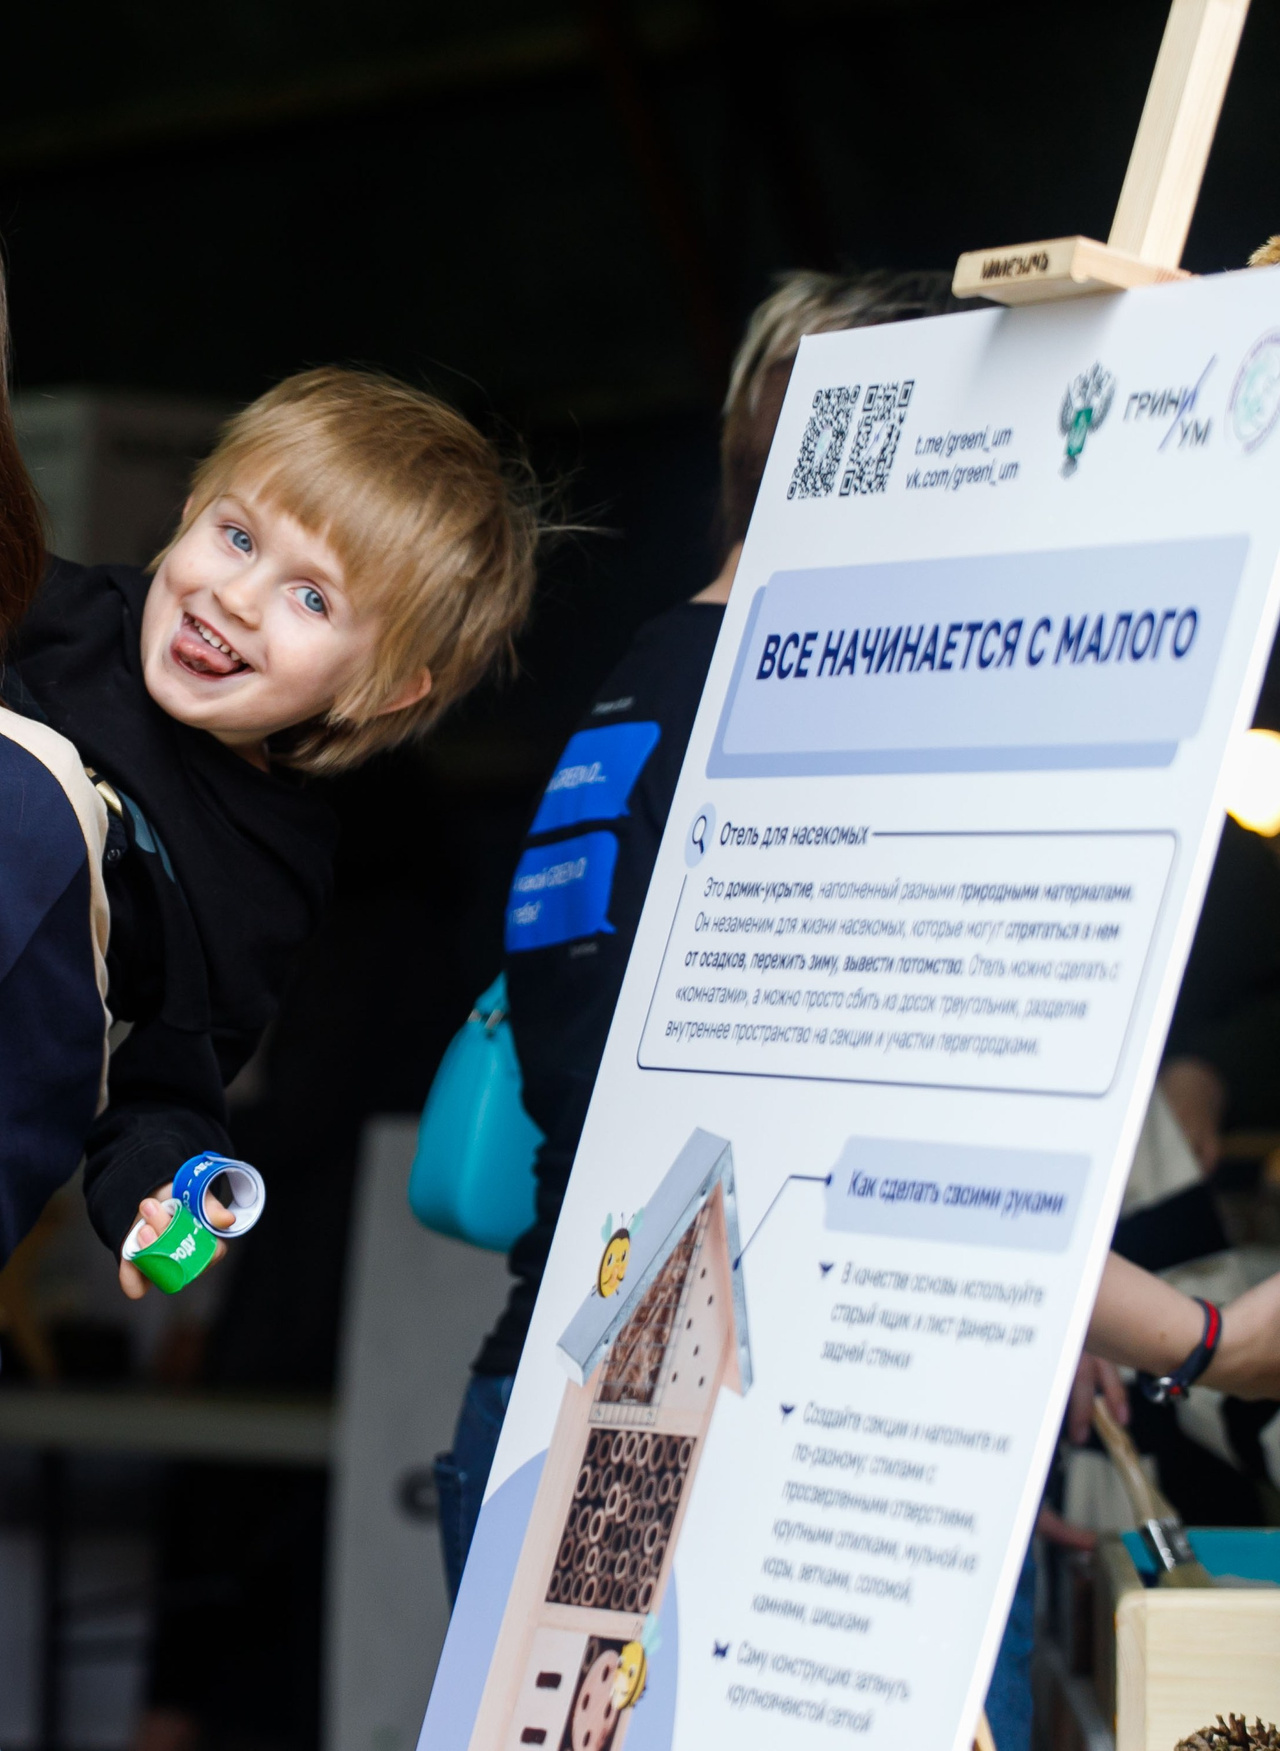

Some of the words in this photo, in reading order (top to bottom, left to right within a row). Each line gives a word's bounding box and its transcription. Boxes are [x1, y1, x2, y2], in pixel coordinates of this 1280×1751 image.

[915, 424, 1012, 458] t.me/greeni_um
[906, 458, 1019, 491] vk.com/greeni_um
[756, 632, 818, 680] ВСЕ
[817, 617, 1024, 679] НАЧИНАЕТСЯ
[1026, 616, 1052, 667] С
[1053, 606, 1200, 665] МАЛОГО
[720, 822, 758, 846] Отель
[760, 826, 786, 849] для
[789, 825, 870, 846] насекомых
[704, 877, 724, 897] Это
[724, 880, 814, 903] домик-укрытие,
[818, 877, 901, 900] наполненный
[899, 883, 956, 904] разными
[958, 882, 1039, 904] природными
[1043, 883, 1133, 906] материалами.
[694, 912, 709, 932] Он
[711, 917, 773, 933] незаменим
[774, 917, 797, 935] для
[800, 918, 836, 935] жизни
[838, 918, 906, 938] насекомых,
[910, 919, 963, 942] которые
[967, 920, 1002, 944] могут
[1005, 921, 1080, 944] спрятаться
[1081, 922, 1092, 939] в
[1093, 922, 1121, 940] нем
[685, 950, 699, 967] от
[699, 951, 747, 970] осадков,
[749, 952, 806, 975] пережить
[807, 954, 838, 976] зиму,
[842, 955, 894, 973] вывести
[894, 956, 964, 975] потомство.
[968, 953, 1005, 977] Отель
[1007, 960, 1052, 979] можно
[1054, 961, 1107, 982] сделать
[1108, 962, 1121, 982] с
[675, 985, 750, 1007] «комнатами»,
[751, 990, 760, 1005] а
[762, 988, 799, 1007] можно
[805, 988, 844, 1013] просто
[845, 987, 880, 1011] сбить
[881, 994, 897, 1011] из
[898, 993, 937, 1014] досок
[940, 995, 1020, 1020] треугольник,
[1022, 998, 1089, 1023] разделив
[665, 1019, 731, 1044] внутреннее
[731, 1022, 810, 1046] пространство
[813, 1026, 827, 1044] на
[829, 1027, 873, 1048] секции
[874, 1030, 884, 1048] и
[886, 1031, 935, 1054] участки
[937, 1033, 1040, 1058] перегородками.
[847, 1169, 877, 1197] Как
[879, 1178, 939, 1204] сделать
[942, 1182, 1002, 1207] своими
[1001, 1190, 1068, 1218] руками
[841, 1261, 852, 1284] В
[852, 1269, 909, 1291] качестве
[910, 1276, 958, 1297] основы
[959, 1279, 1046, 1311] используйте
[830, 1302, 877, 1326] старый
[879, 1310, 910, 1332] ящик
[912, 1314, 922, 1331] и
[924, 1314, 955, 1335] лист
[955, 1316, 1007, 1344] фанеры
[1009, 1324, 1038, 1346] для
[820, 1339, 866, 1363] задней
[867, 1347, 914, 1370] стенки
[803, 1402, 863, 1431] Создайте
[862, 1414, 910, 1439] секции
[920, 1423, 991, 1448] наполните
[782, 1480, 890, 1514] просверленными
[773, 1519, 834, 1545] крупными
[770, 1653, 852, 1687] конструкцию
